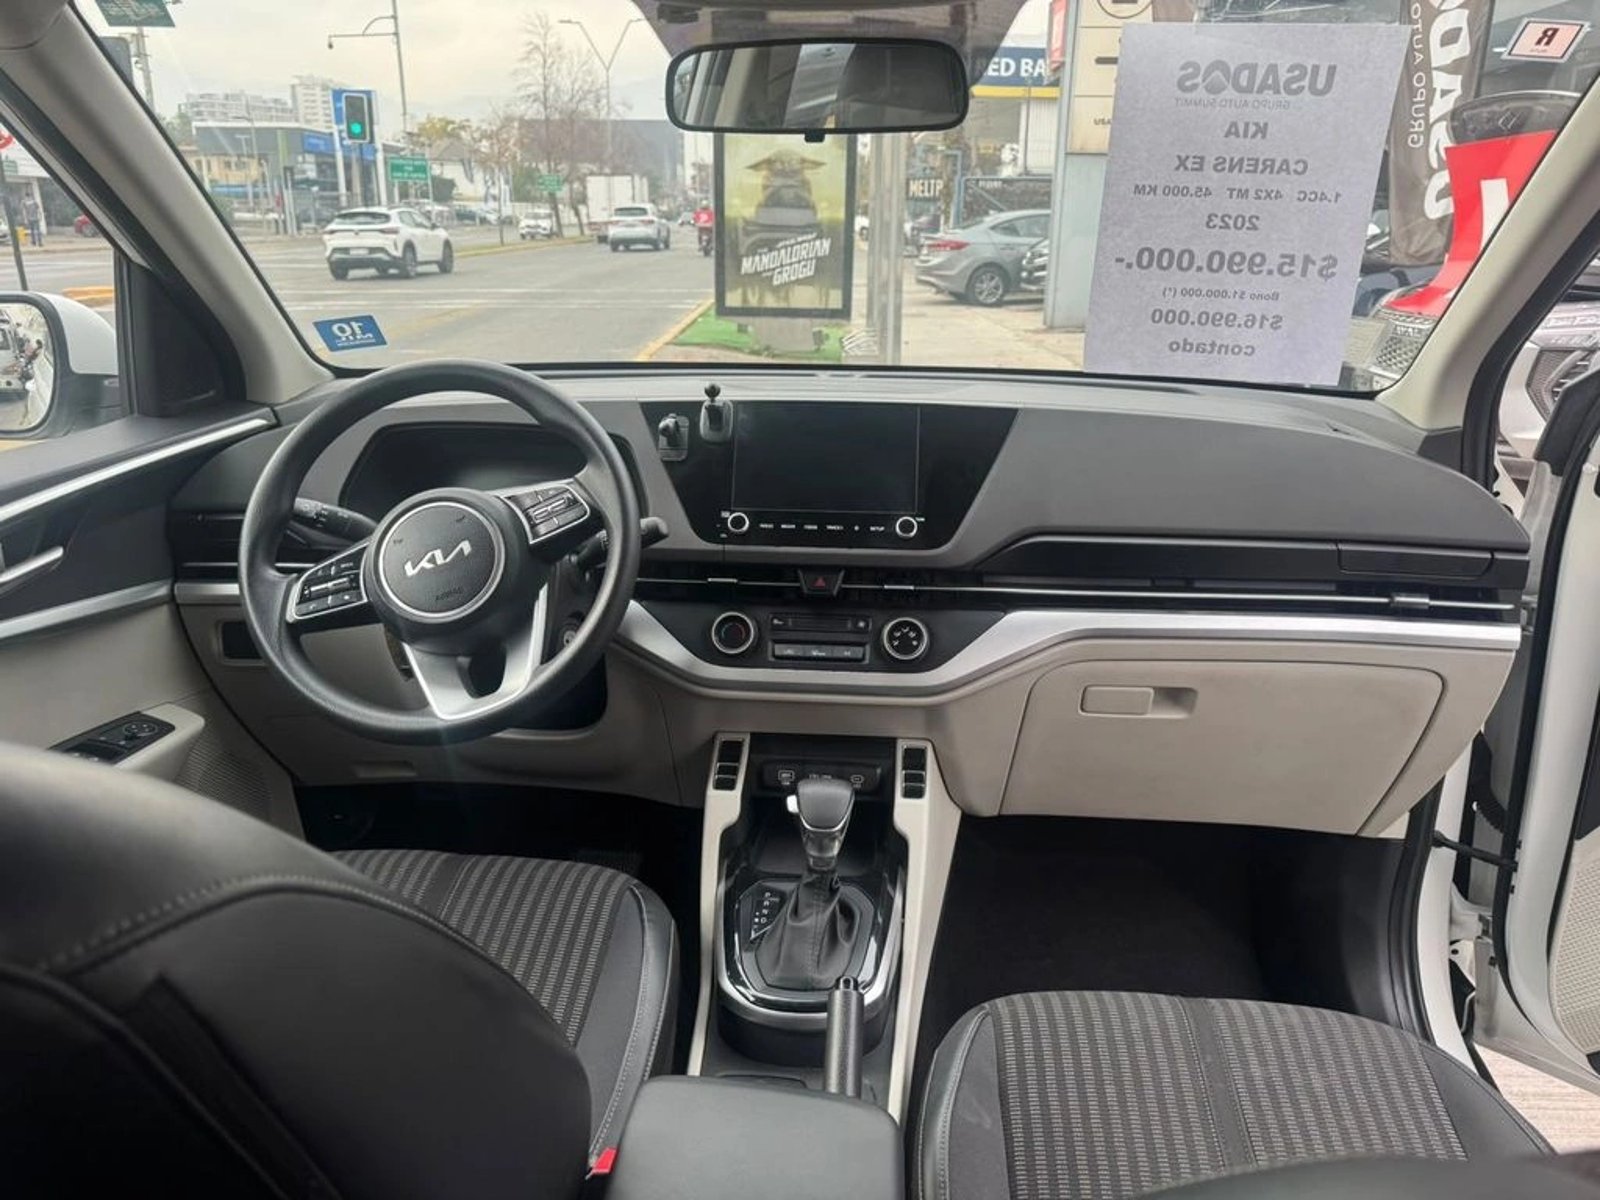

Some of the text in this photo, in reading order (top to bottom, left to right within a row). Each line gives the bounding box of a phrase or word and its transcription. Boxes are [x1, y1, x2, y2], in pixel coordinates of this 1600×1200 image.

[985, 57, 1048, 77] ED BA
[772, 259, 816, 286] GROGU
